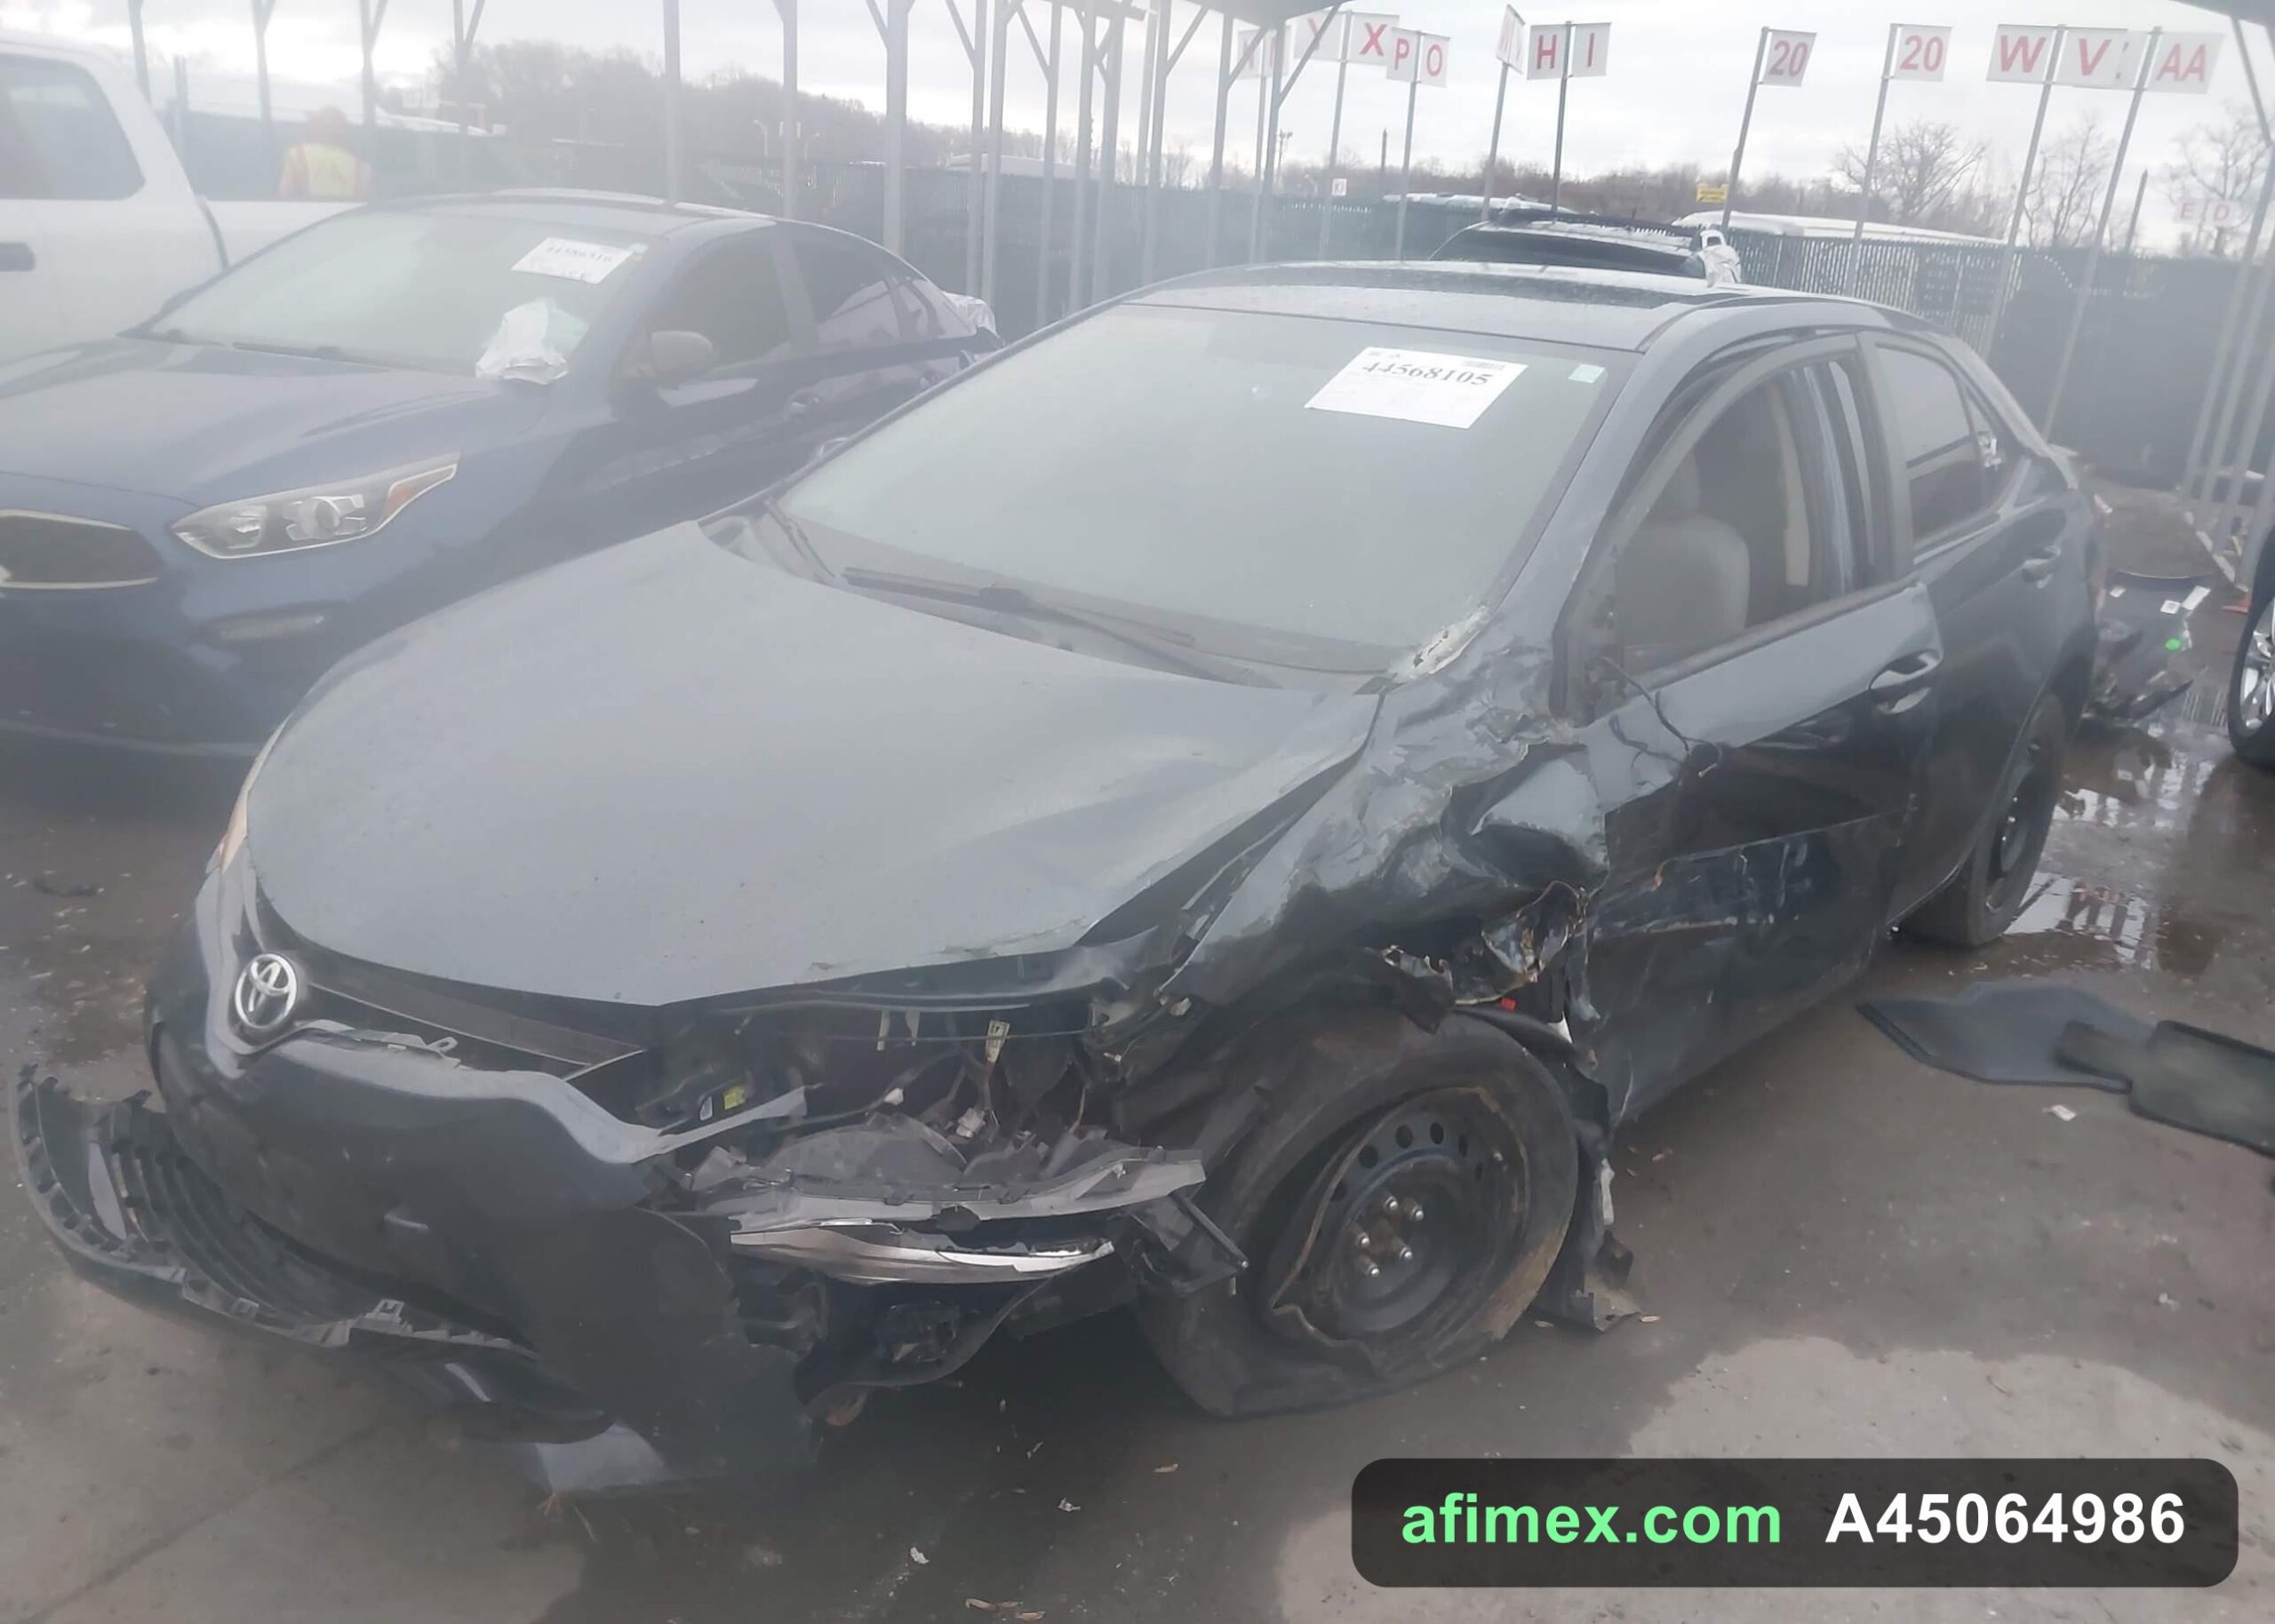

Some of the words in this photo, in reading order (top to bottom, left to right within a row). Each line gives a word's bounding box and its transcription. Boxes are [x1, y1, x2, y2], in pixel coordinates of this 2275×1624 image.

[1359, 21, 1387, 57] X
[1393, 37, 1410, 71] P
[1536, 34, 1557, 70] H
[1586, 32, 1595, 68] I
[1899, 34, 1944, 73] 20
[2000, 35, 2048, 73] W
[2078, 37, 2112, 76] V
[1767, 40, 1808, 77] 20
[2154, 42, 2207, 83] AA
[1361, 362, 1494, 386] 44568105
